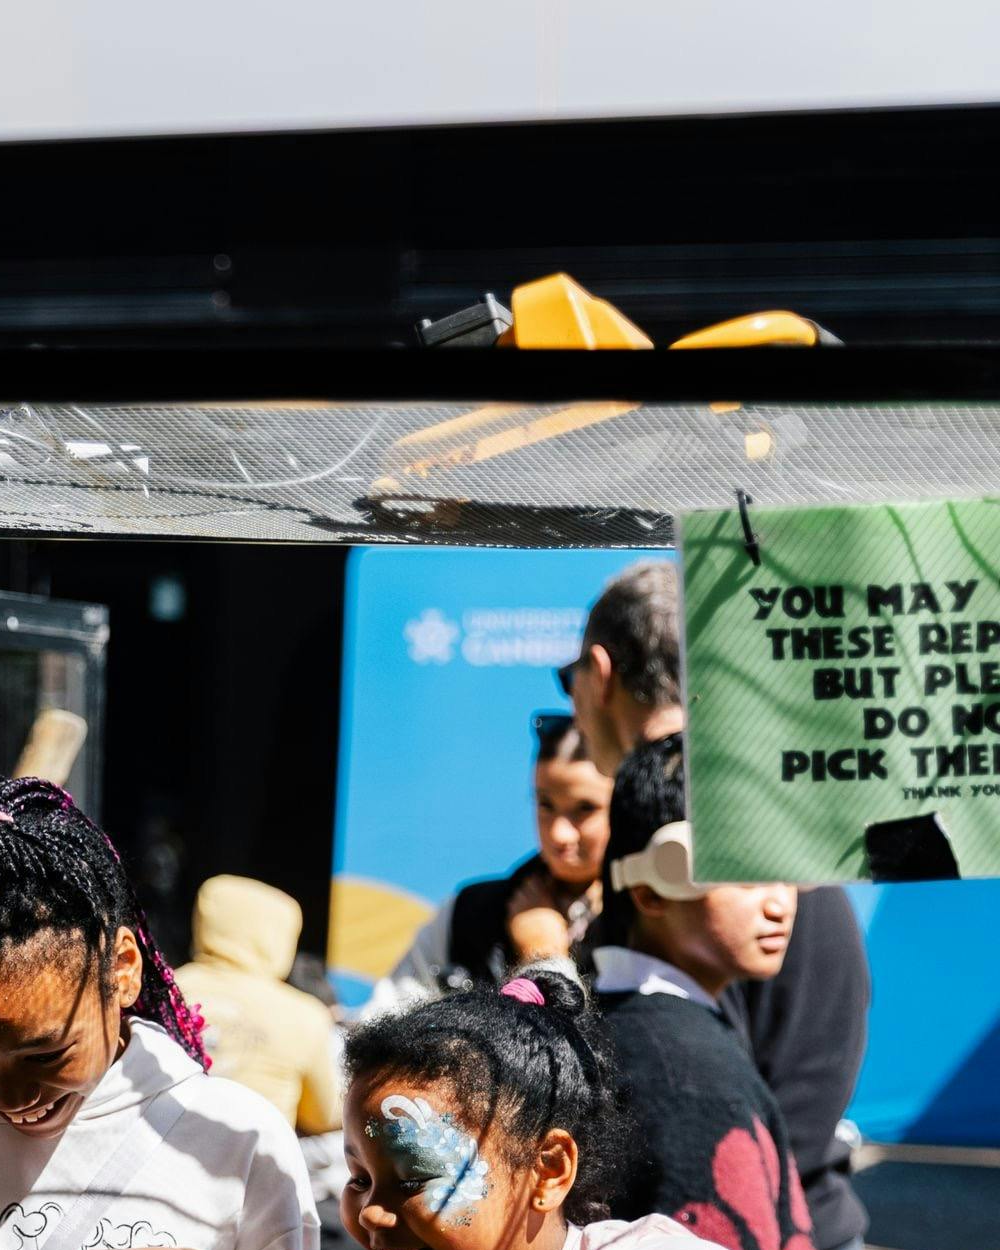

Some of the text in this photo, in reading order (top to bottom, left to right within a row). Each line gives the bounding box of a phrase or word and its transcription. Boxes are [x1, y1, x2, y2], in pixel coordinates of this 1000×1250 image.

[748, 580, 979, 620] YOU MAY
[767, 625, 894, 661] THESE
[812, 667, 901, 701] BUT
[862, 706, 930, 741] DO
[781, 743, 1000, 782] PICK THE
[902, 783, 962, 801] THANK
